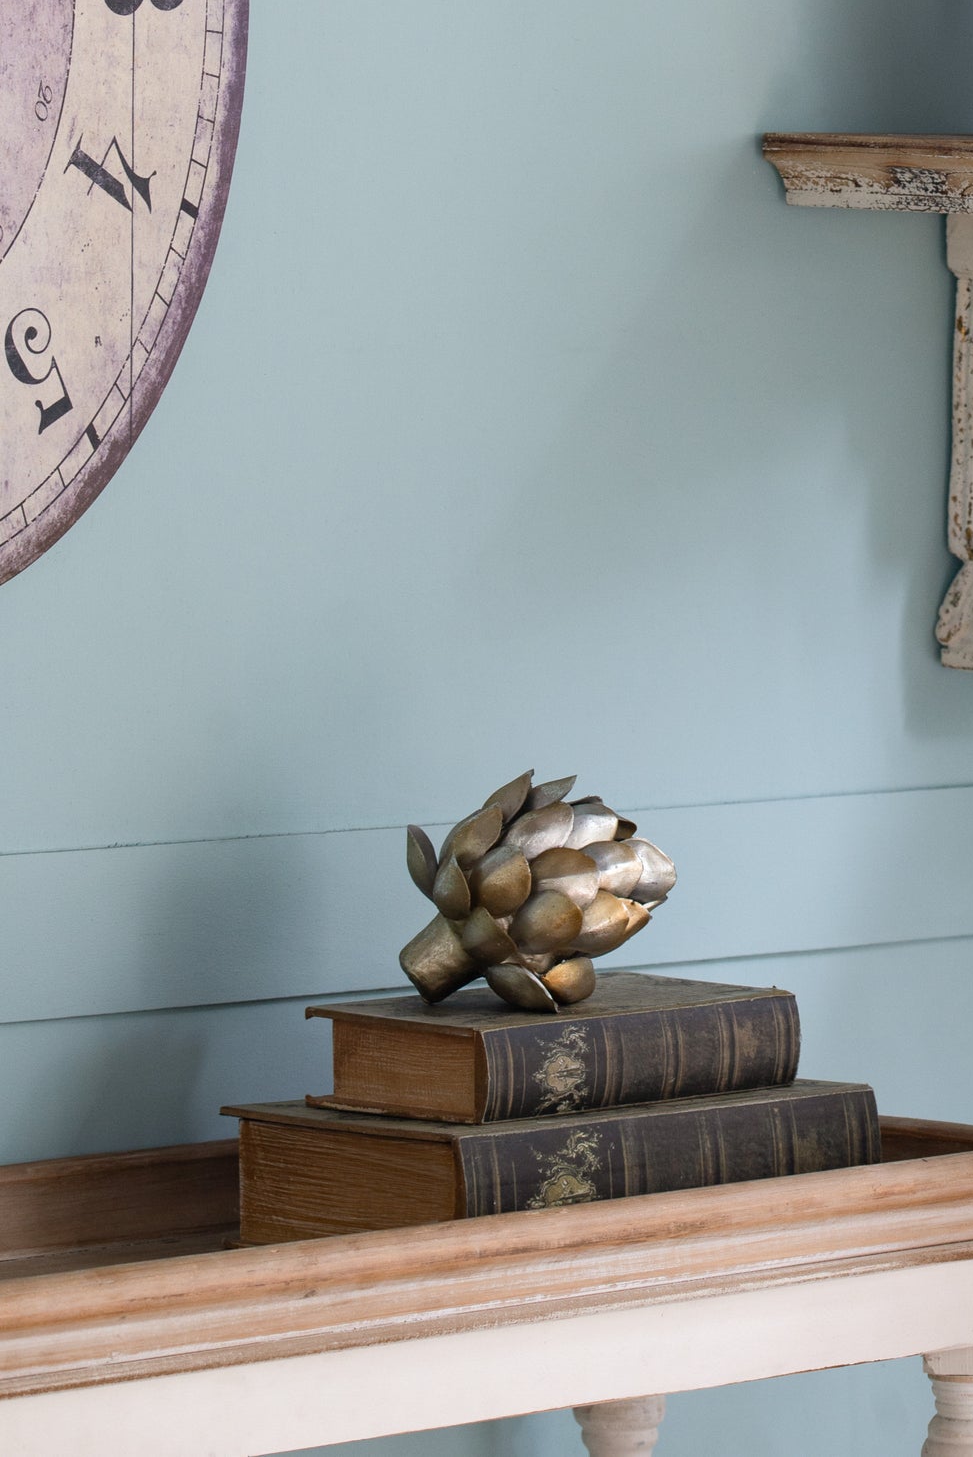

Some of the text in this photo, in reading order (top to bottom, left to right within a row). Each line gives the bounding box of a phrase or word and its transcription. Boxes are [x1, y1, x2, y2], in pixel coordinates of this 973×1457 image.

[34, 80, 53, 122] 20
[63, 132, 157, 214] 4
[4, 307, 73, 435] 5
